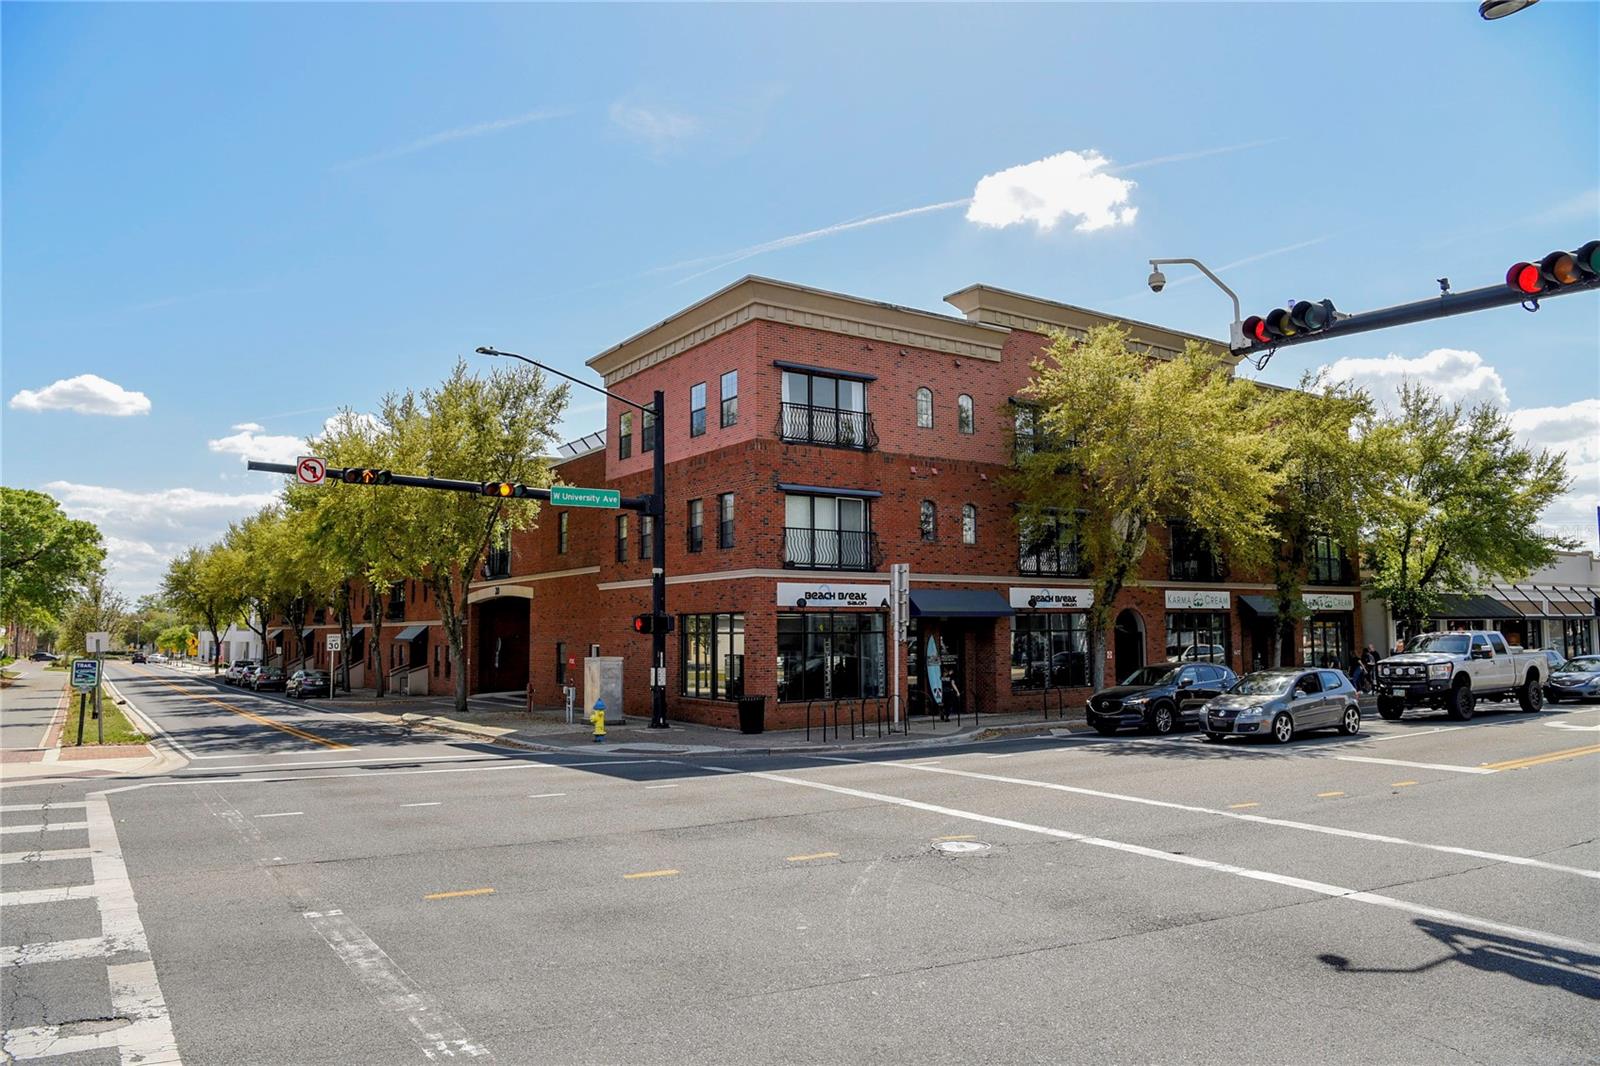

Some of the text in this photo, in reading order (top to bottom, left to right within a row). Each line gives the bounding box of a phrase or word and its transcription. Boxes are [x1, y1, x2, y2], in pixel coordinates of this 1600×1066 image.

[553, 492, 618, 504] W University Ave
[1167, 594, 1228, 605] KARMA CREAM
[328, 642, 340, 650] 30
